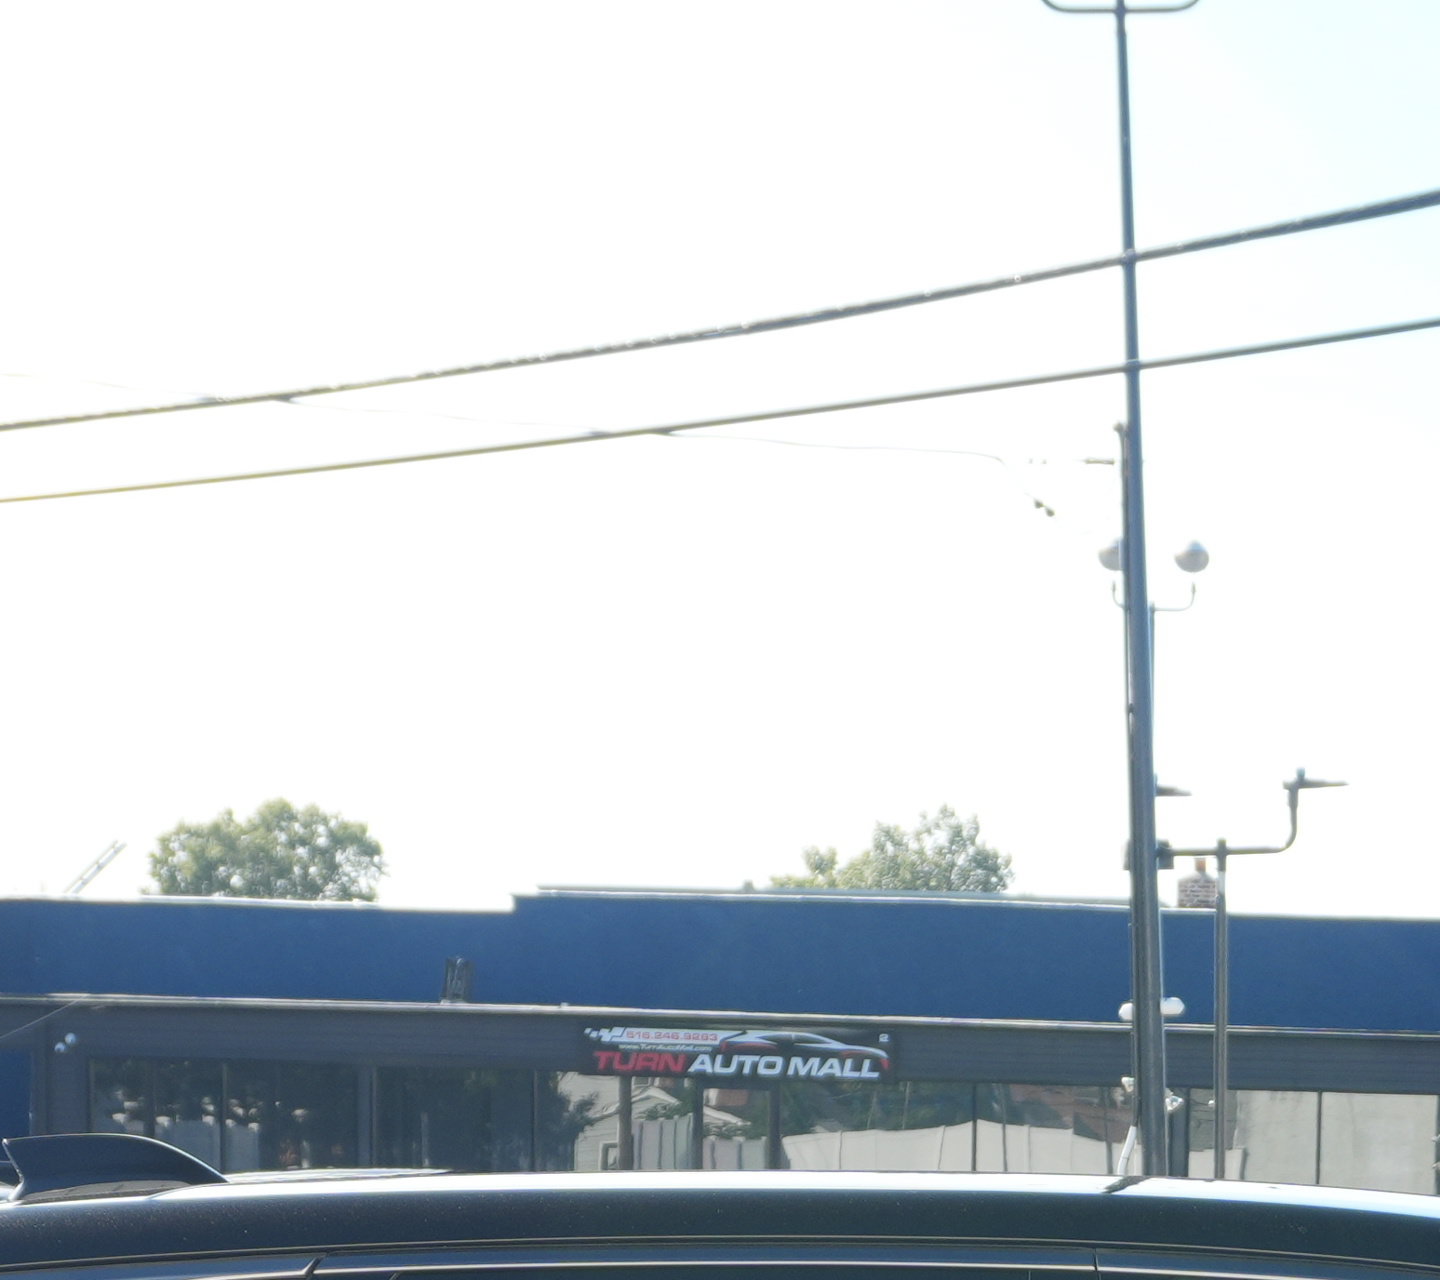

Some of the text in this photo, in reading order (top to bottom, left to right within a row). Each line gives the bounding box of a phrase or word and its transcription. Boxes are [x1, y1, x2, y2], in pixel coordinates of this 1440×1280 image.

[594, 1050, 880, 1077] TURN AUTO MALL
